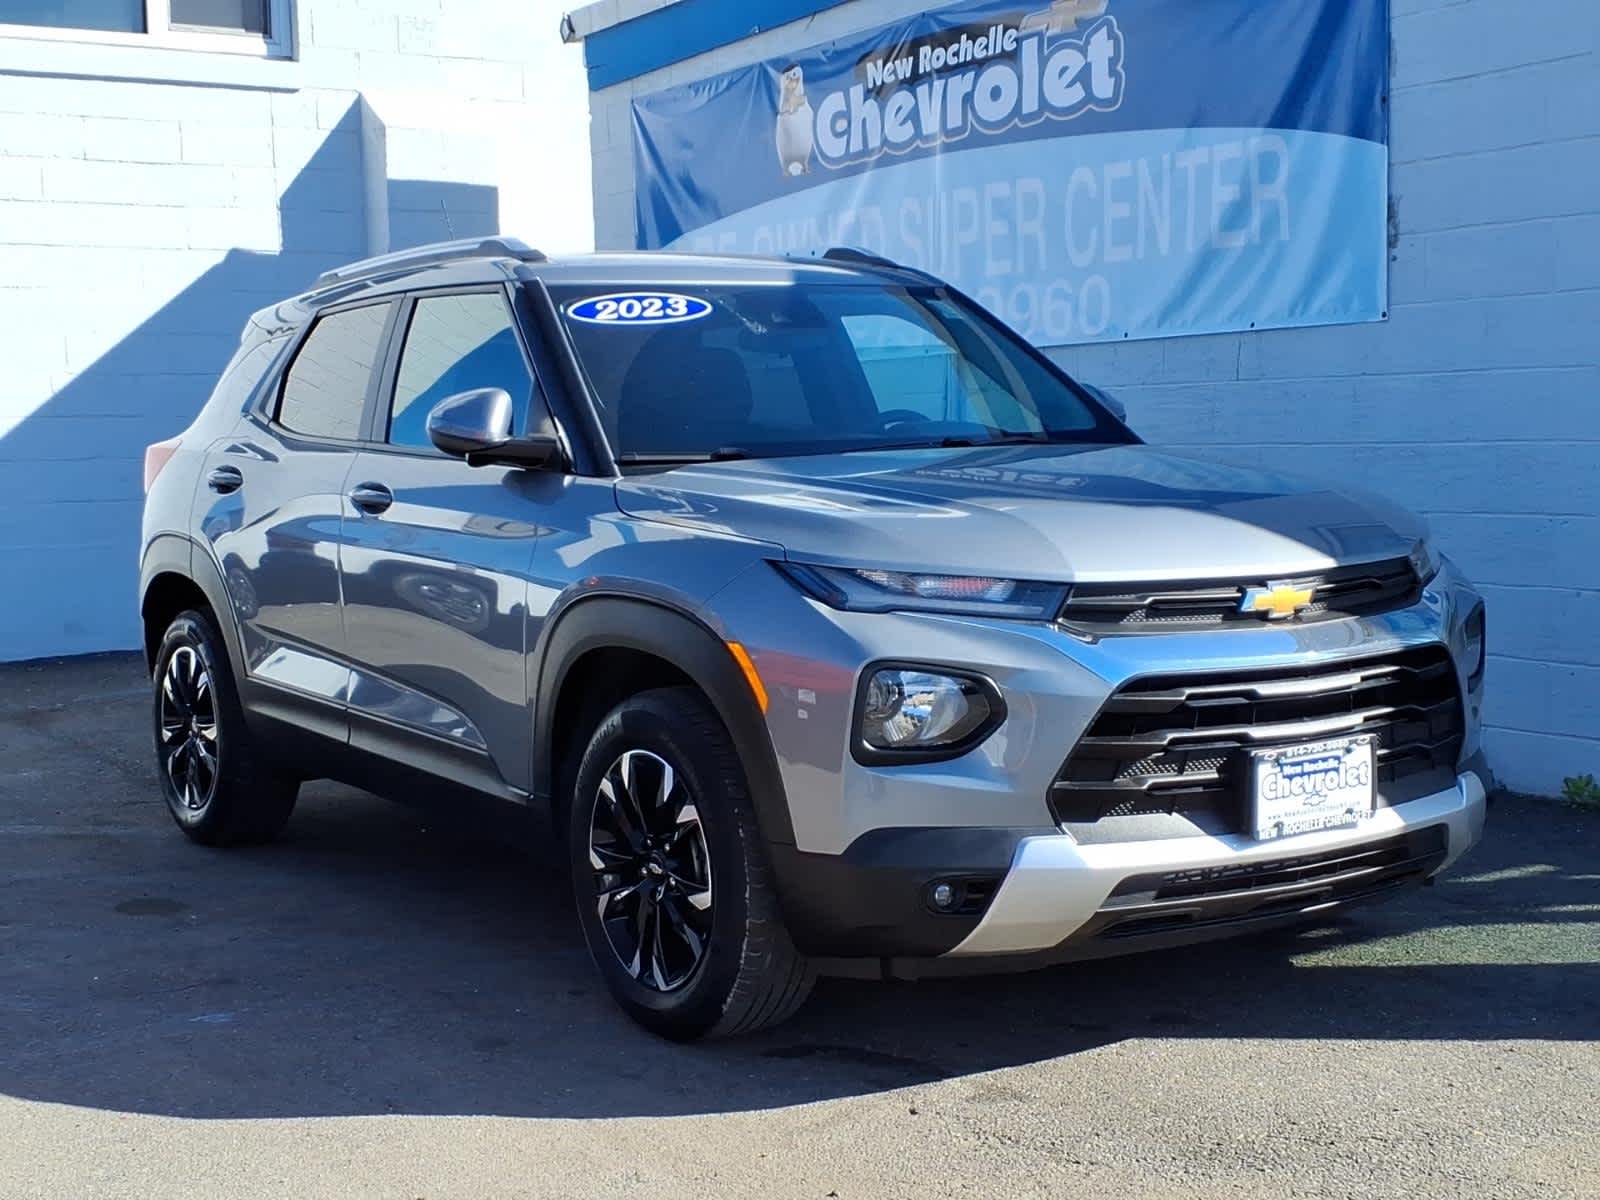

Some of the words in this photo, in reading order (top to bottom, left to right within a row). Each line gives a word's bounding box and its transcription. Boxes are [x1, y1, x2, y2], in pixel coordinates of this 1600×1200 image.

[865, 56, 914, 88] New
[919, 24, 1018, 73] Rochelle
[815, 25, 1116, 160] Chevrolet
[899, 177, 1047, 281] SUPER
[1064, 134, 1291, 268] CENTER
[595, 296, 689, 321] 2023
[1262, 761, 1368, 800] Chevrolet
